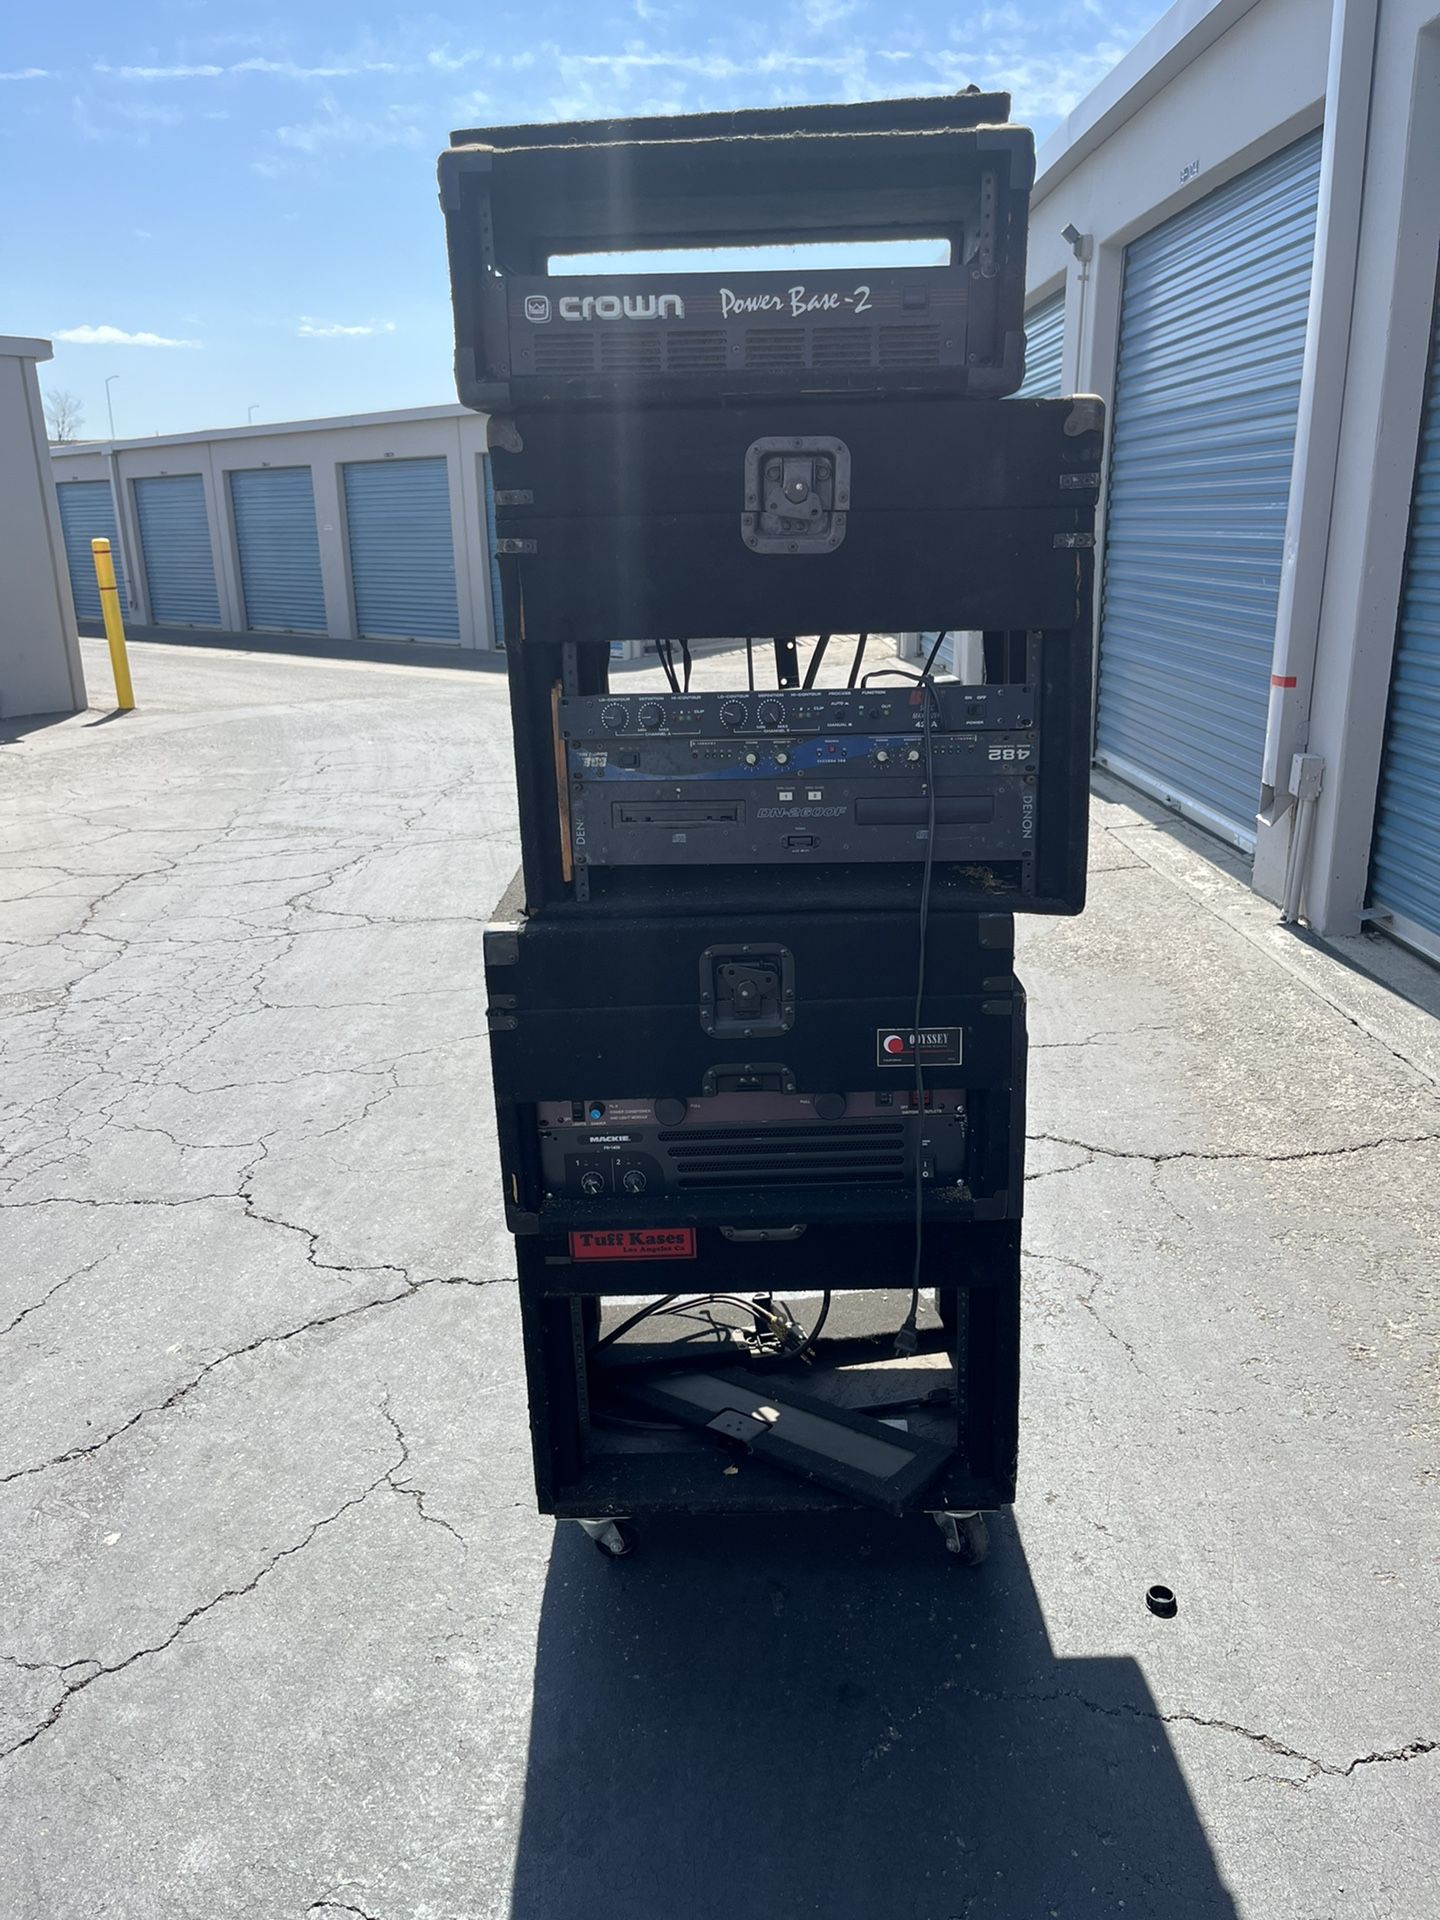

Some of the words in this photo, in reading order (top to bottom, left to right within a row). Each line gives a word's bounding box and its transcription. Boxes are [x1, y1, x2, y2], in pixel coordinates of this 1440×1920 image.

[720, 288, 784, 319] Power
[788, 286, 872, 316] Base-2
[915, 720, 938, 728] 42A
[988, 749, 1031, 761] 482
[1022, 796, 1032, 838] DENON
[581, 1233, 624, 1247] Tuff
[628, 1232, 685, 1245] Kases
